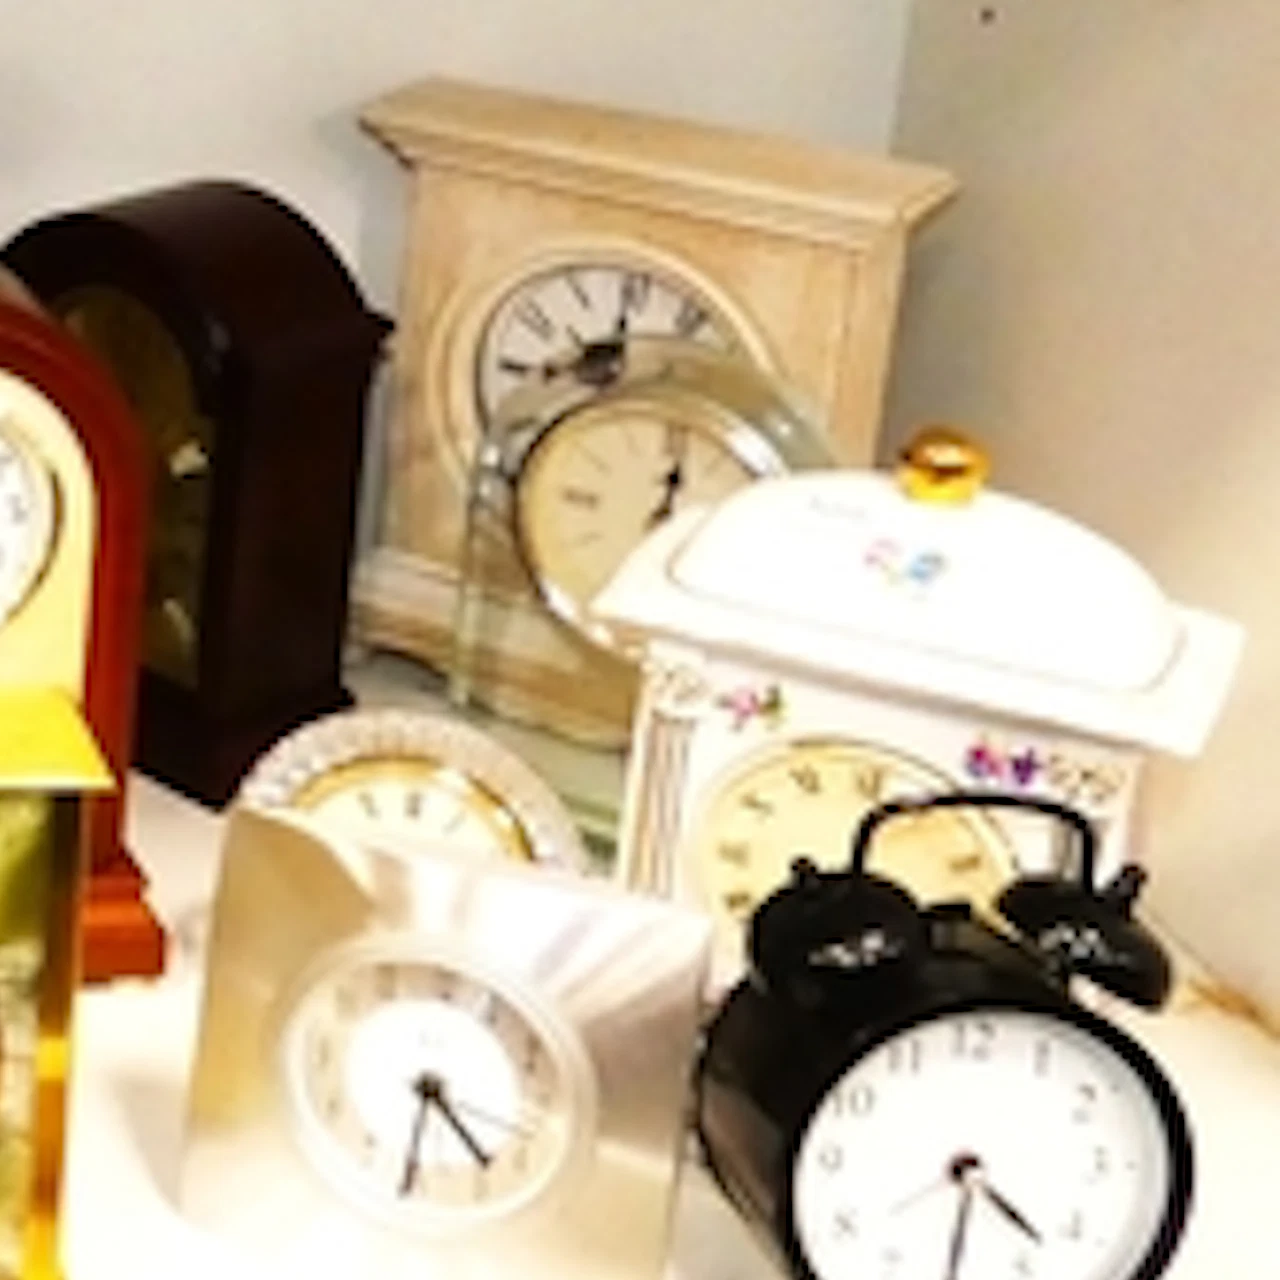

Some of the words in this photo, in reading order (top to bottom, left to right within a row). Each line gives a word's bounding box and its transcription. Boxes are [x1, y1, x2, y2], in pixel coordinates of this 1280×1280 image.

[886, 1037, 922, 1074] 11
[952, 1021, 997, 1061] 12
[831, 1085, 875, 1118] 10
